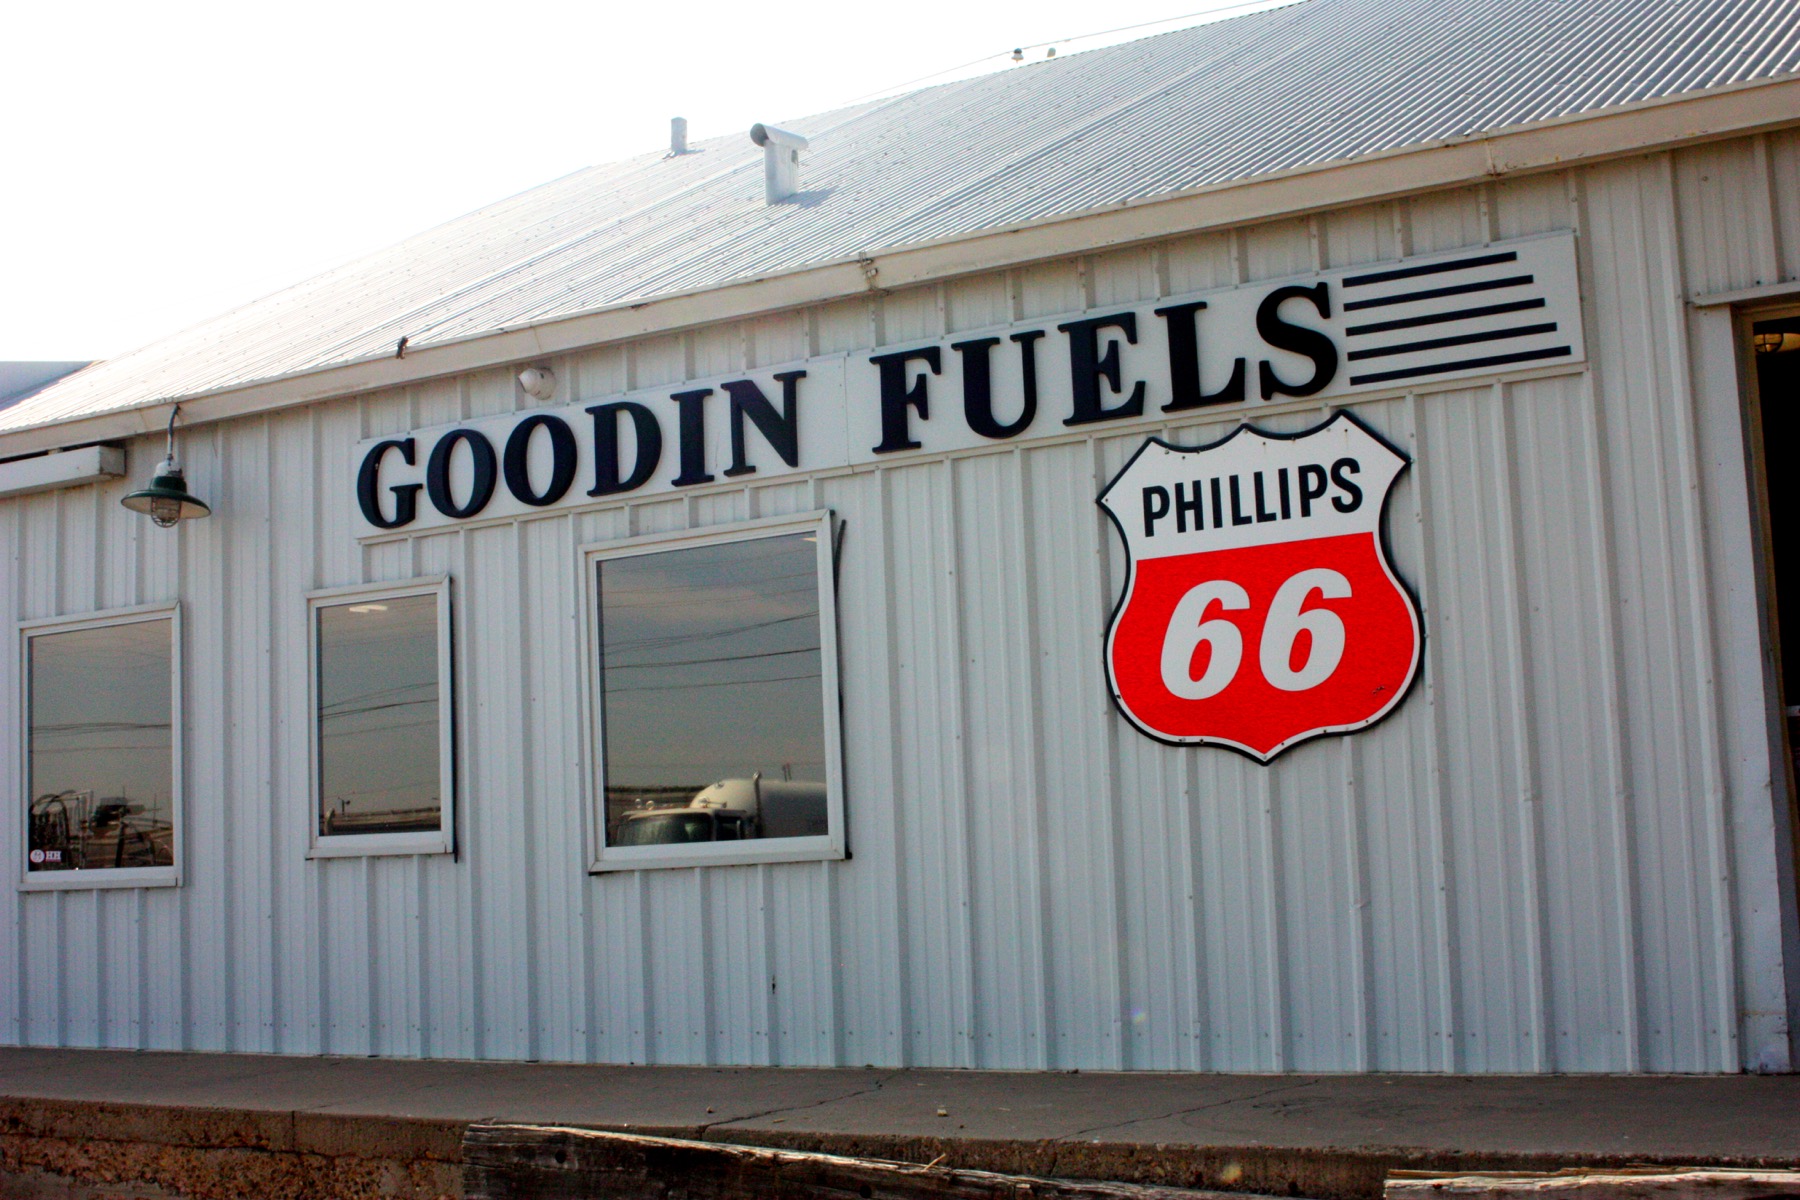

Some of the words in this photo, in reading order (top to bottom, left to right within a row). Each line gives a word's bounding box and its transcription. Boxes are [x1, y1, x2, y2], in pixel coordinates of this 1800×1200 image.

[357, 371, 806, 529] GOODIN
[869, 282, 1338, 454] FUELS
[1142, 457, 1363, 537] PHILLIPS
[1160, 567, 1352, 700] 66
